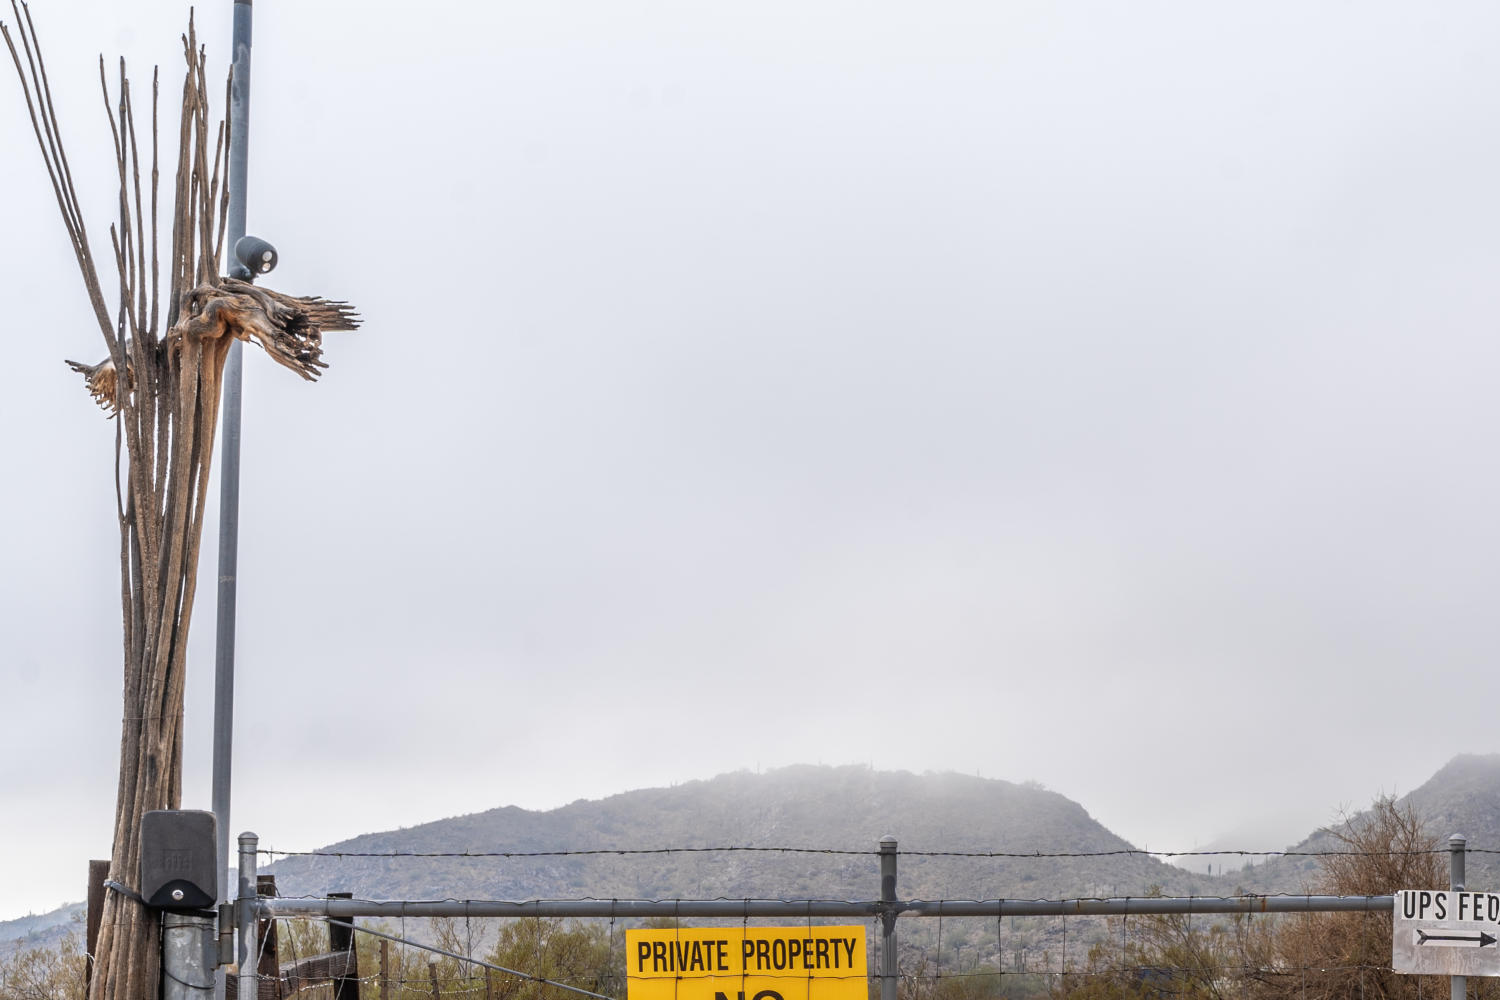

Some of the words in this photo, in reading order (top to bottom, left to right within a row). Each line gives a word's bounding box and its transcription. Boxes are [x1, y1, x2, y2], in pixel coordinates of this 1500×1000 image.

[1403, 891, 1447, 919] UPS
[637, 940, 728, 972] PRIVATE
[743, 938, 856, 970] PROPERTY
